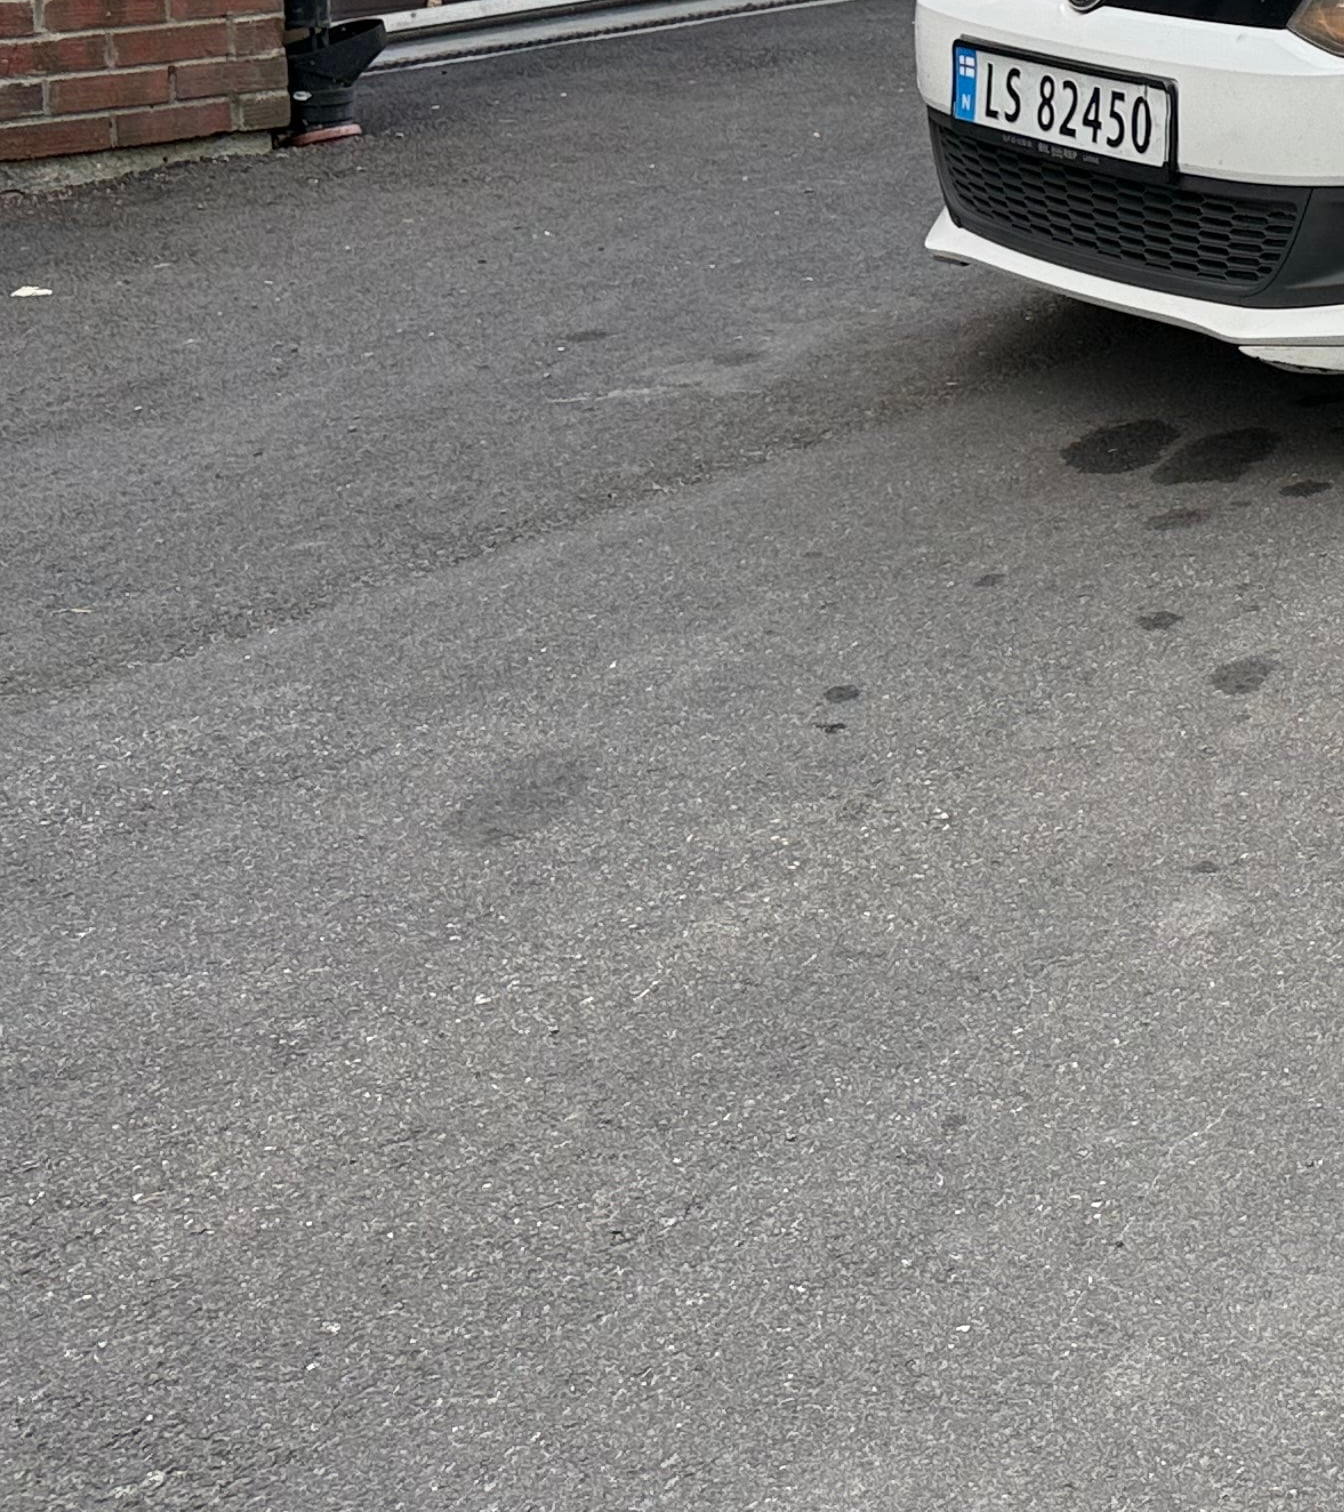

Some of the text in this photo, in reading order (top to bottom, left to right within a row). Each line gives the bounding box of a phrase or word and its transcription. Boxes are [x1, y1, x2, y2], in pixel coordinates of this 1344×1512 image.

[961, 93, 971, 112] N
[985, 62, 1022, 124] LS
[1037, 74, 1151, 155] 82450
